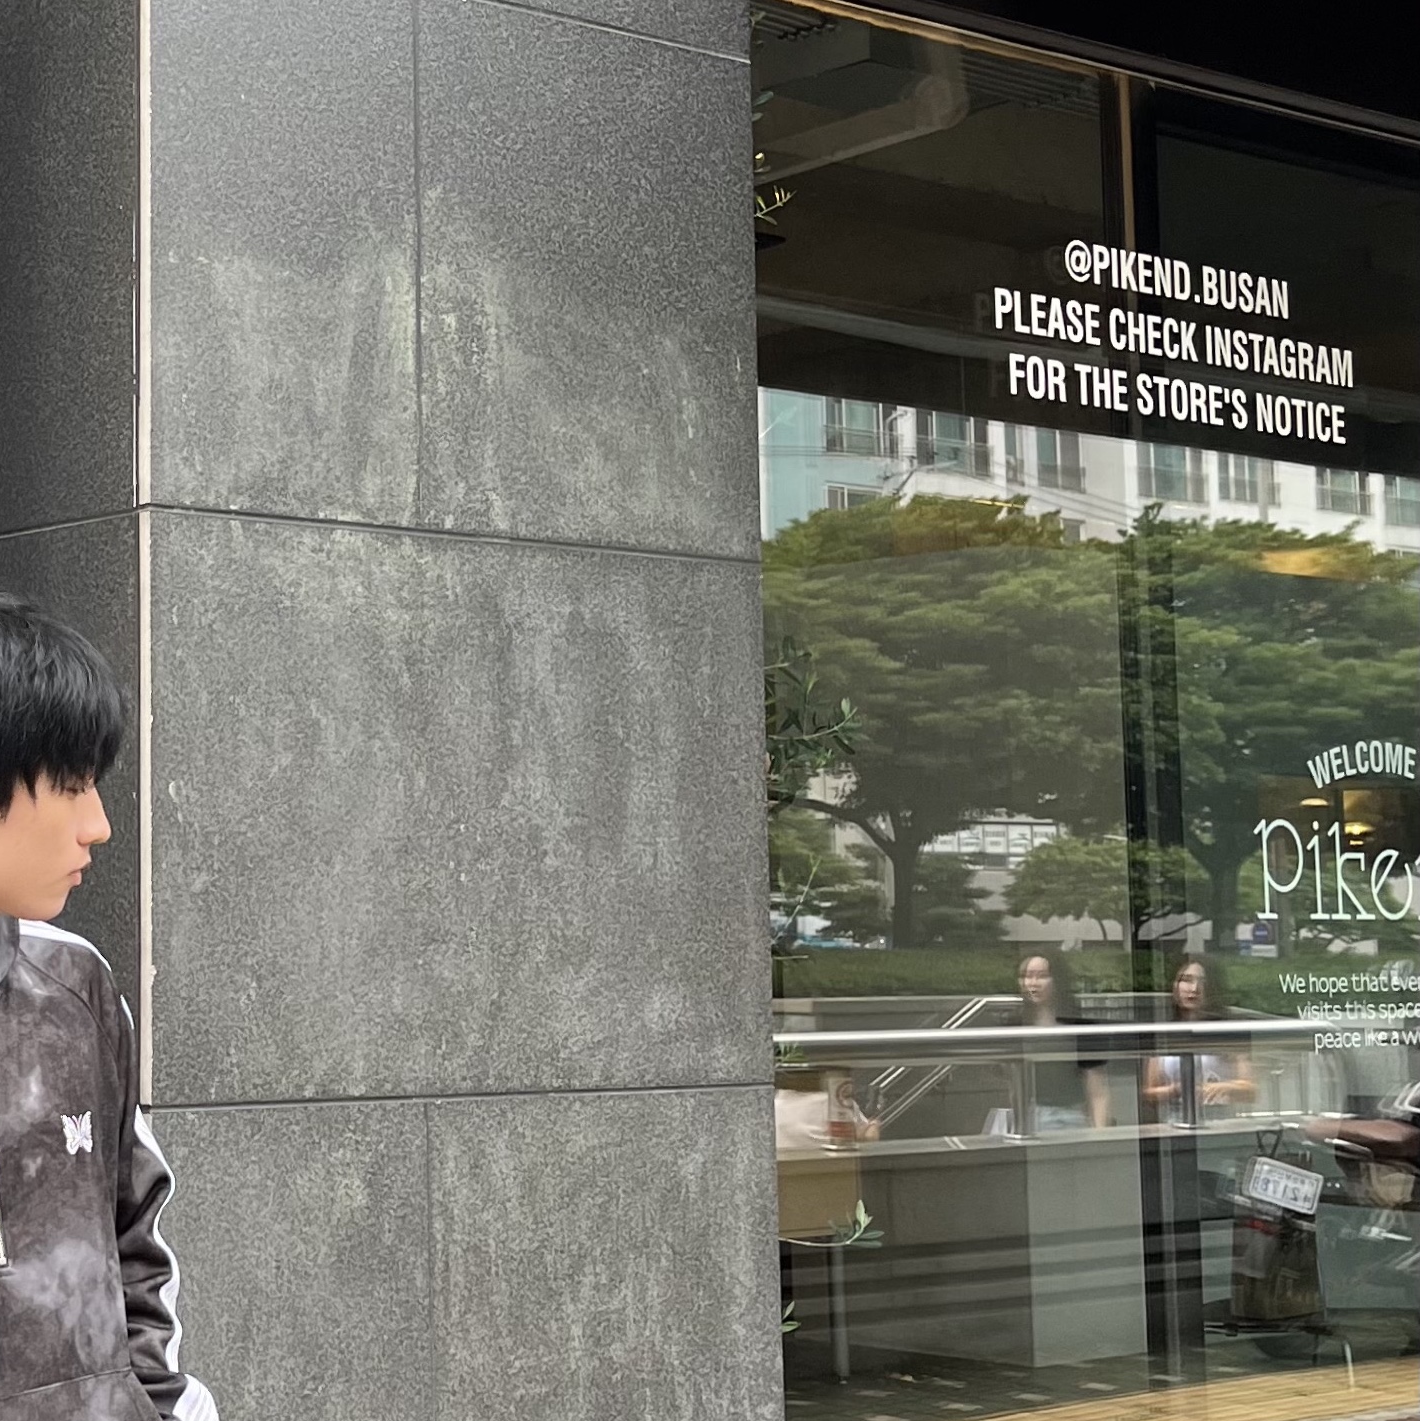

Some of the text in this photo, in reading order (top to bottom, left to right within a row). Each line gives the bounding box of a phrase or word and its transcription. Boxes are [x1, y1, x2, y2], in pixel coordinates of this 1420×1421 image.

[1064, 239, 1289, 320] @PIKEND.BUSAN
[994, 287, 1354, 388] PLEASE CHECK INSTAGRAM
[1009, 353, 1346, 444] FOR THE STORE'S NOTICE
[1307, 740, 1417, 789] WELCOME
[1253, 818, 1420, 921] pike
[1279, 973, 1306, 993] We
[1309, 972, 1348, 998] hope
[1351, 972, 1388, 992] that
[1297, 1001, 1341, 1020] visits
[1345, 1000, 1376, 1020] this
[1314, 1032, 1361, 1055] peace
[1364, 1028, 1388, 1046] like
[1390, 1031, 1399, 1046] a
